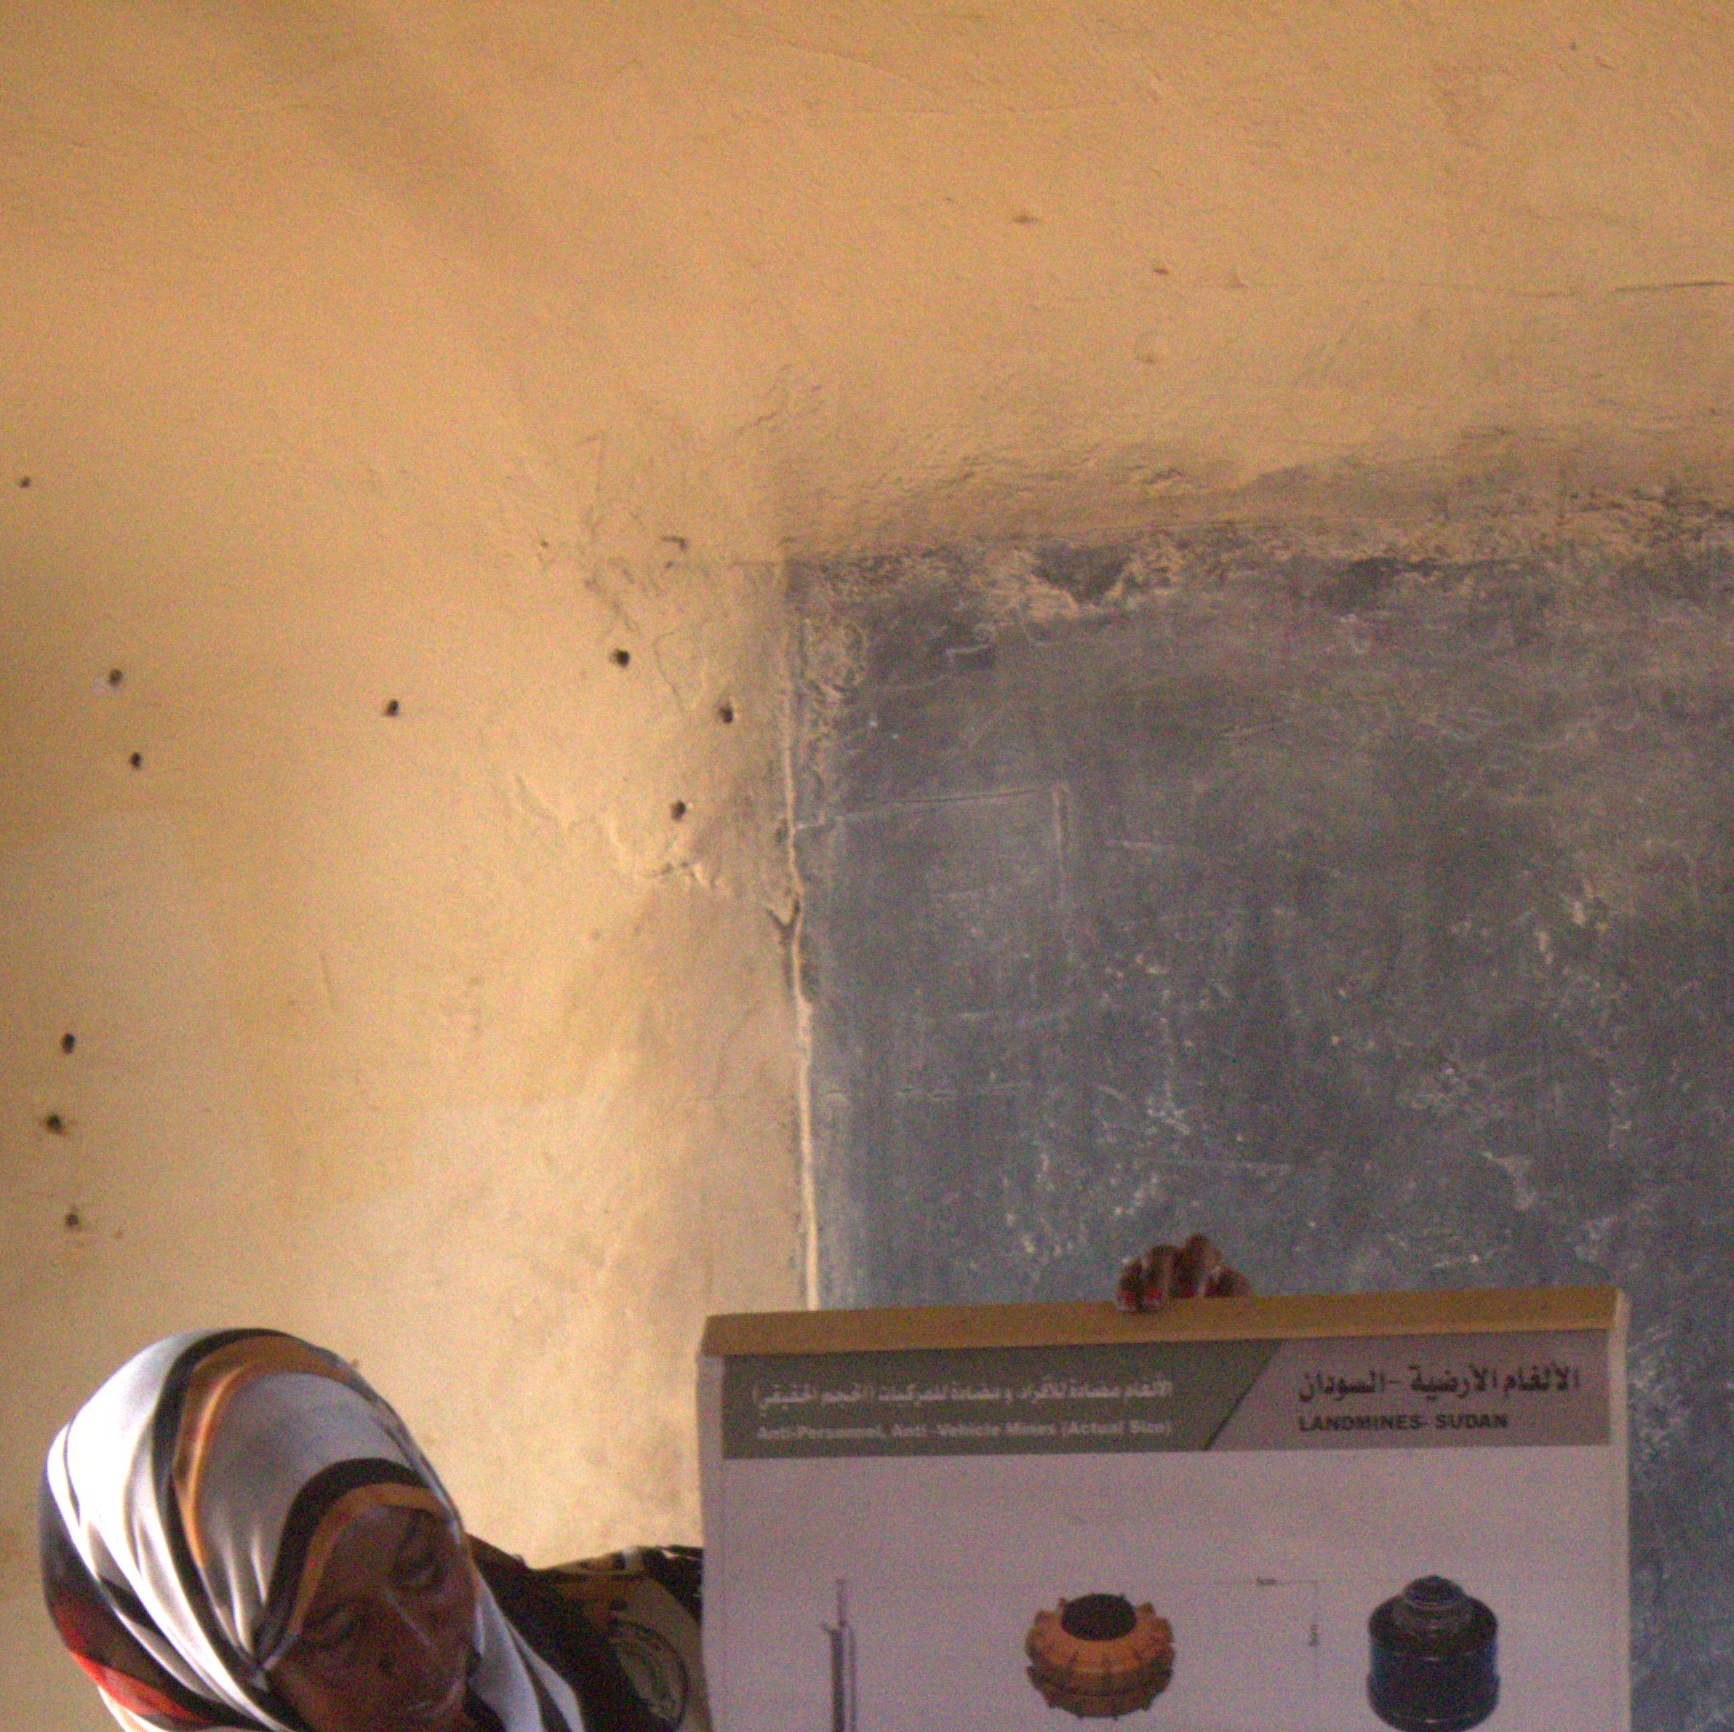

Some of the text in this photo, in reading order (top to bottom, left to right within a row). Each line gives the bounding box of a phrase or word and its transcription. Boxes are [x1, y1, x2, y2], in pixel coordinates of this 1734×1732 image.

[1005, 1420, 1057, 1437] Mines
[1061, 1419, 1125, 1438] (Actual
[1435, 1412, 1508, 1430] SUDAN
